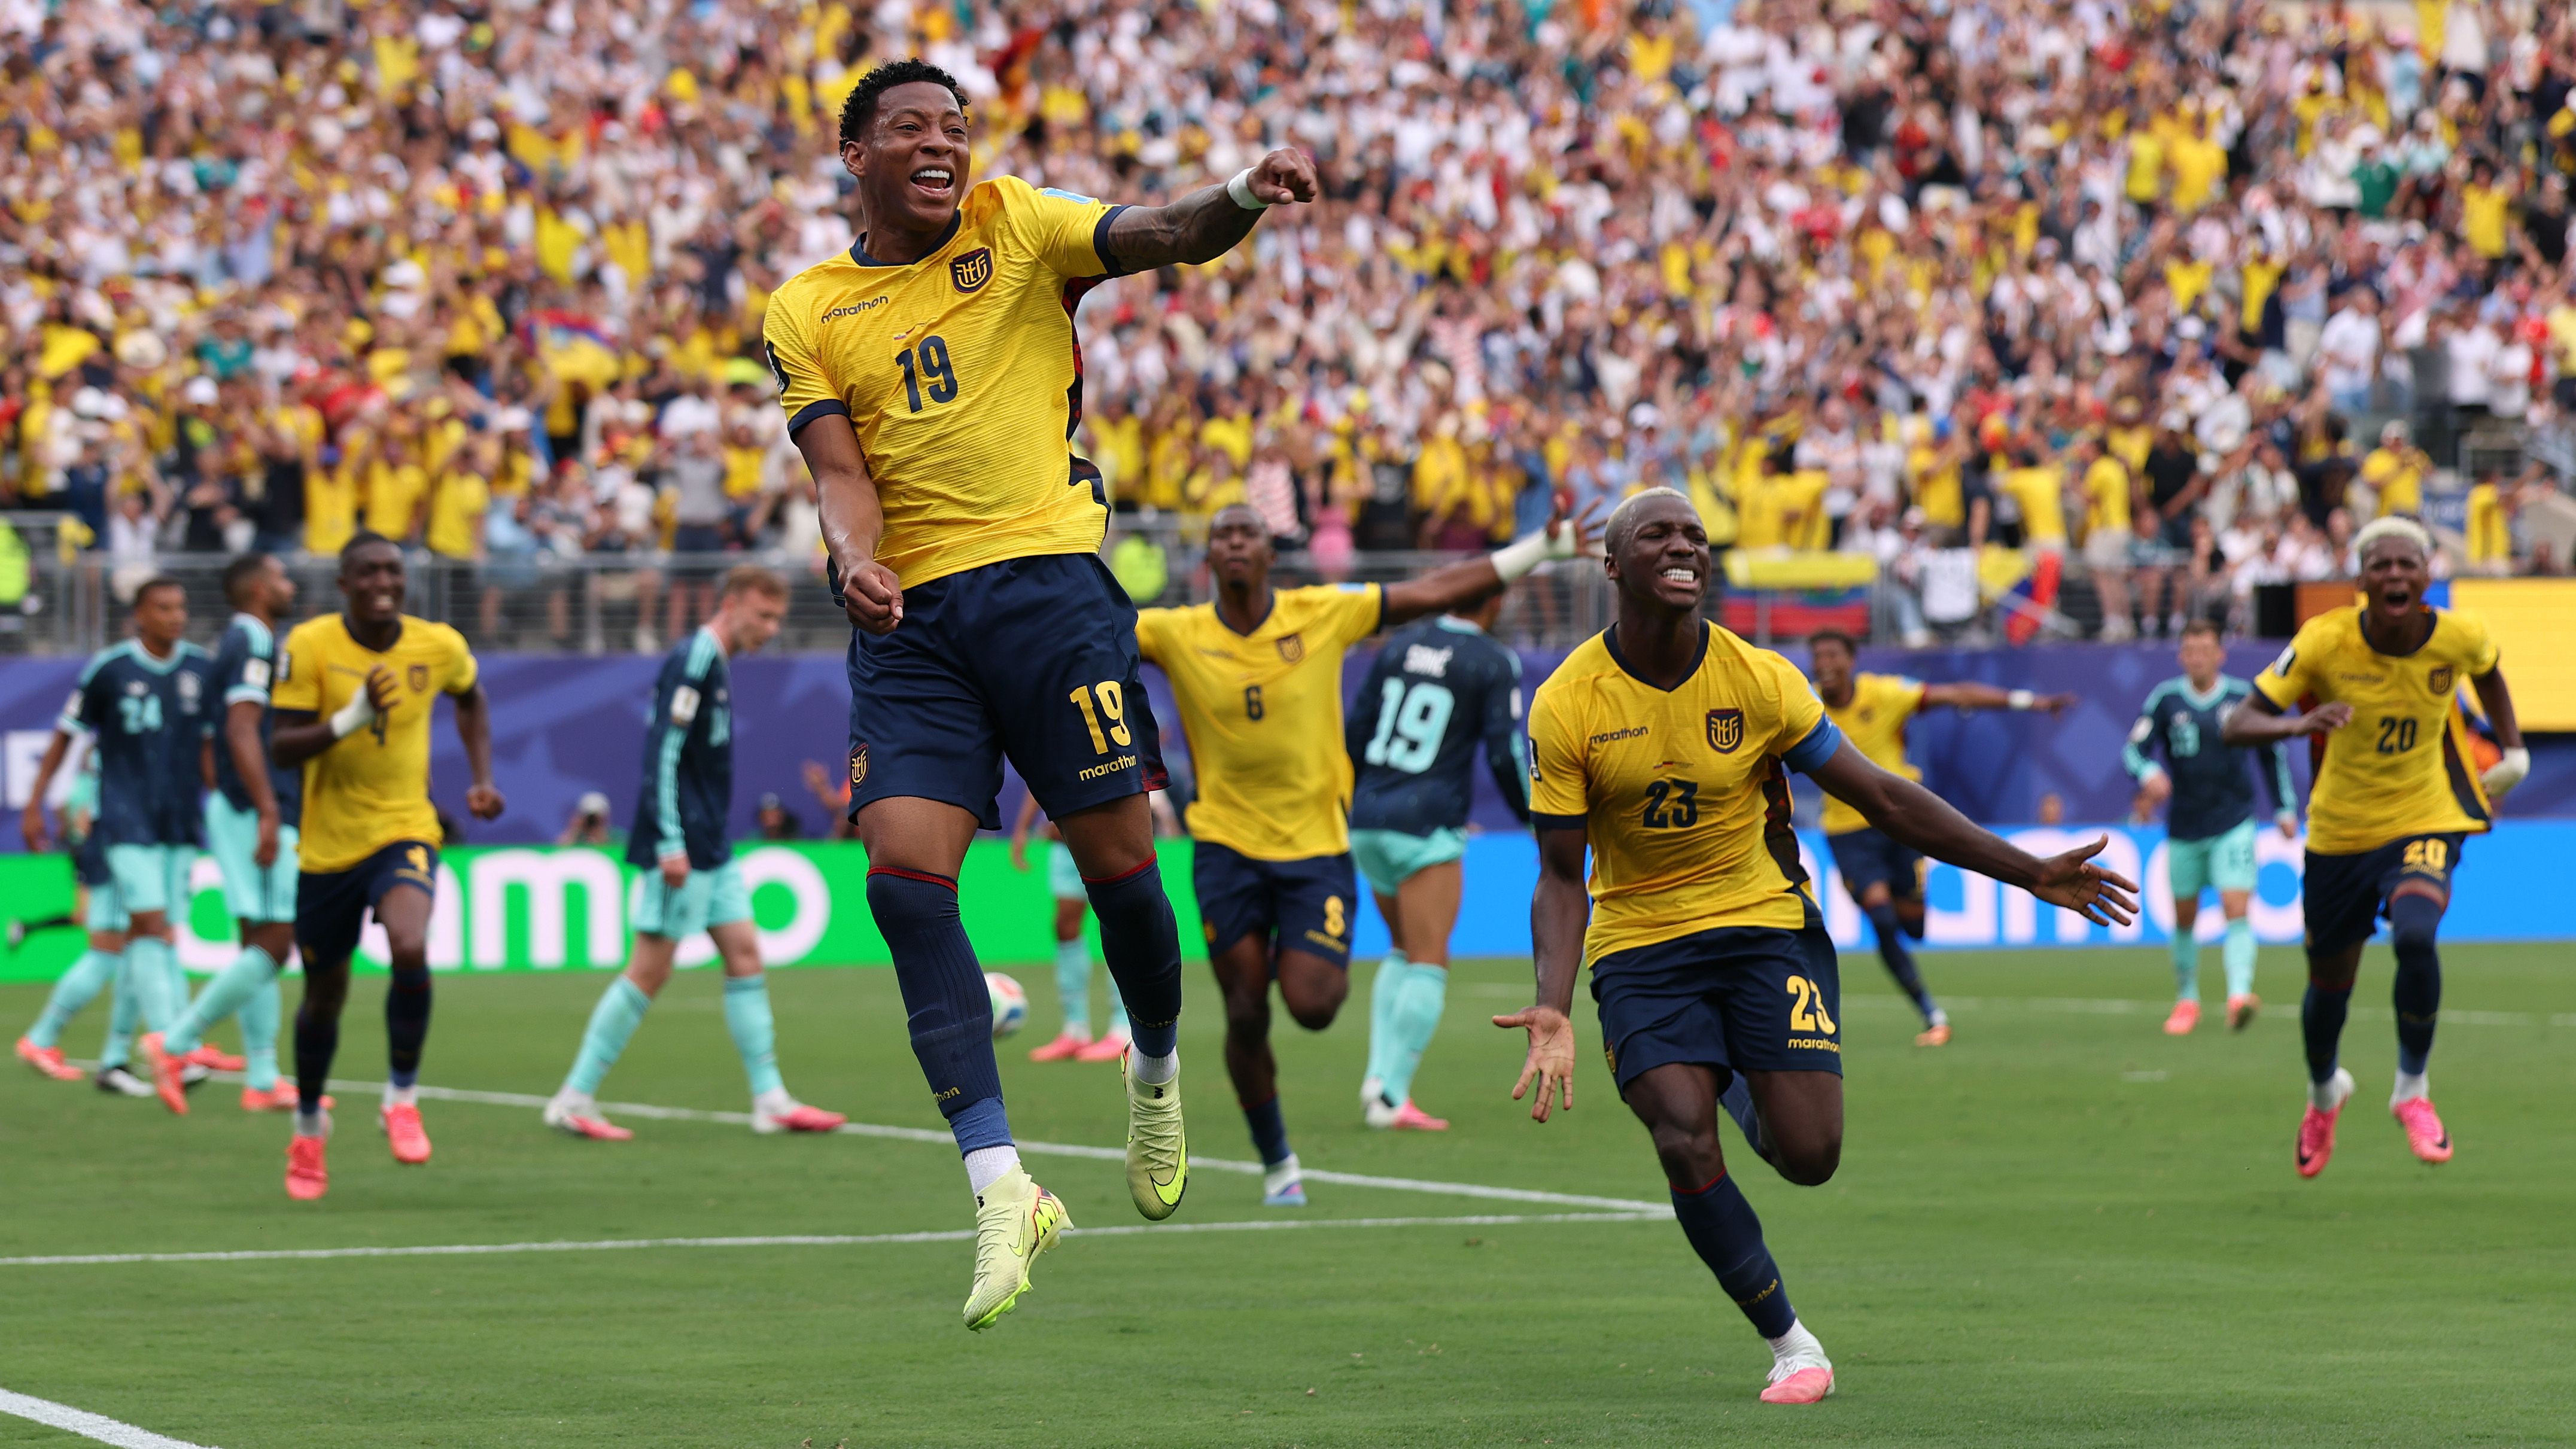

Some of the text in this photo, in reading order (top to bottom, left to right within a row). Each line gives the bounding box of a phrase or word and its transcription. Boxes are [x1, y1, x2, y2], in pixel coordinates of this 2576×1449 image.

[822, 296, 889, 324] marathon
[895, 336, 958, 413] 19
[1070, 681, 1131, 754] 19
[1245, 685, 1264, 721] 6
[1365, 676, 1455, 774] 19
[1589, 726, 1649, 745] marathon
[2377, 716, 2417, 754] 20
[1643, 779, 1698, 828] 23
[2402, 838, 2448, 871] 20
[1786, 975, 1836, 1035] 23
